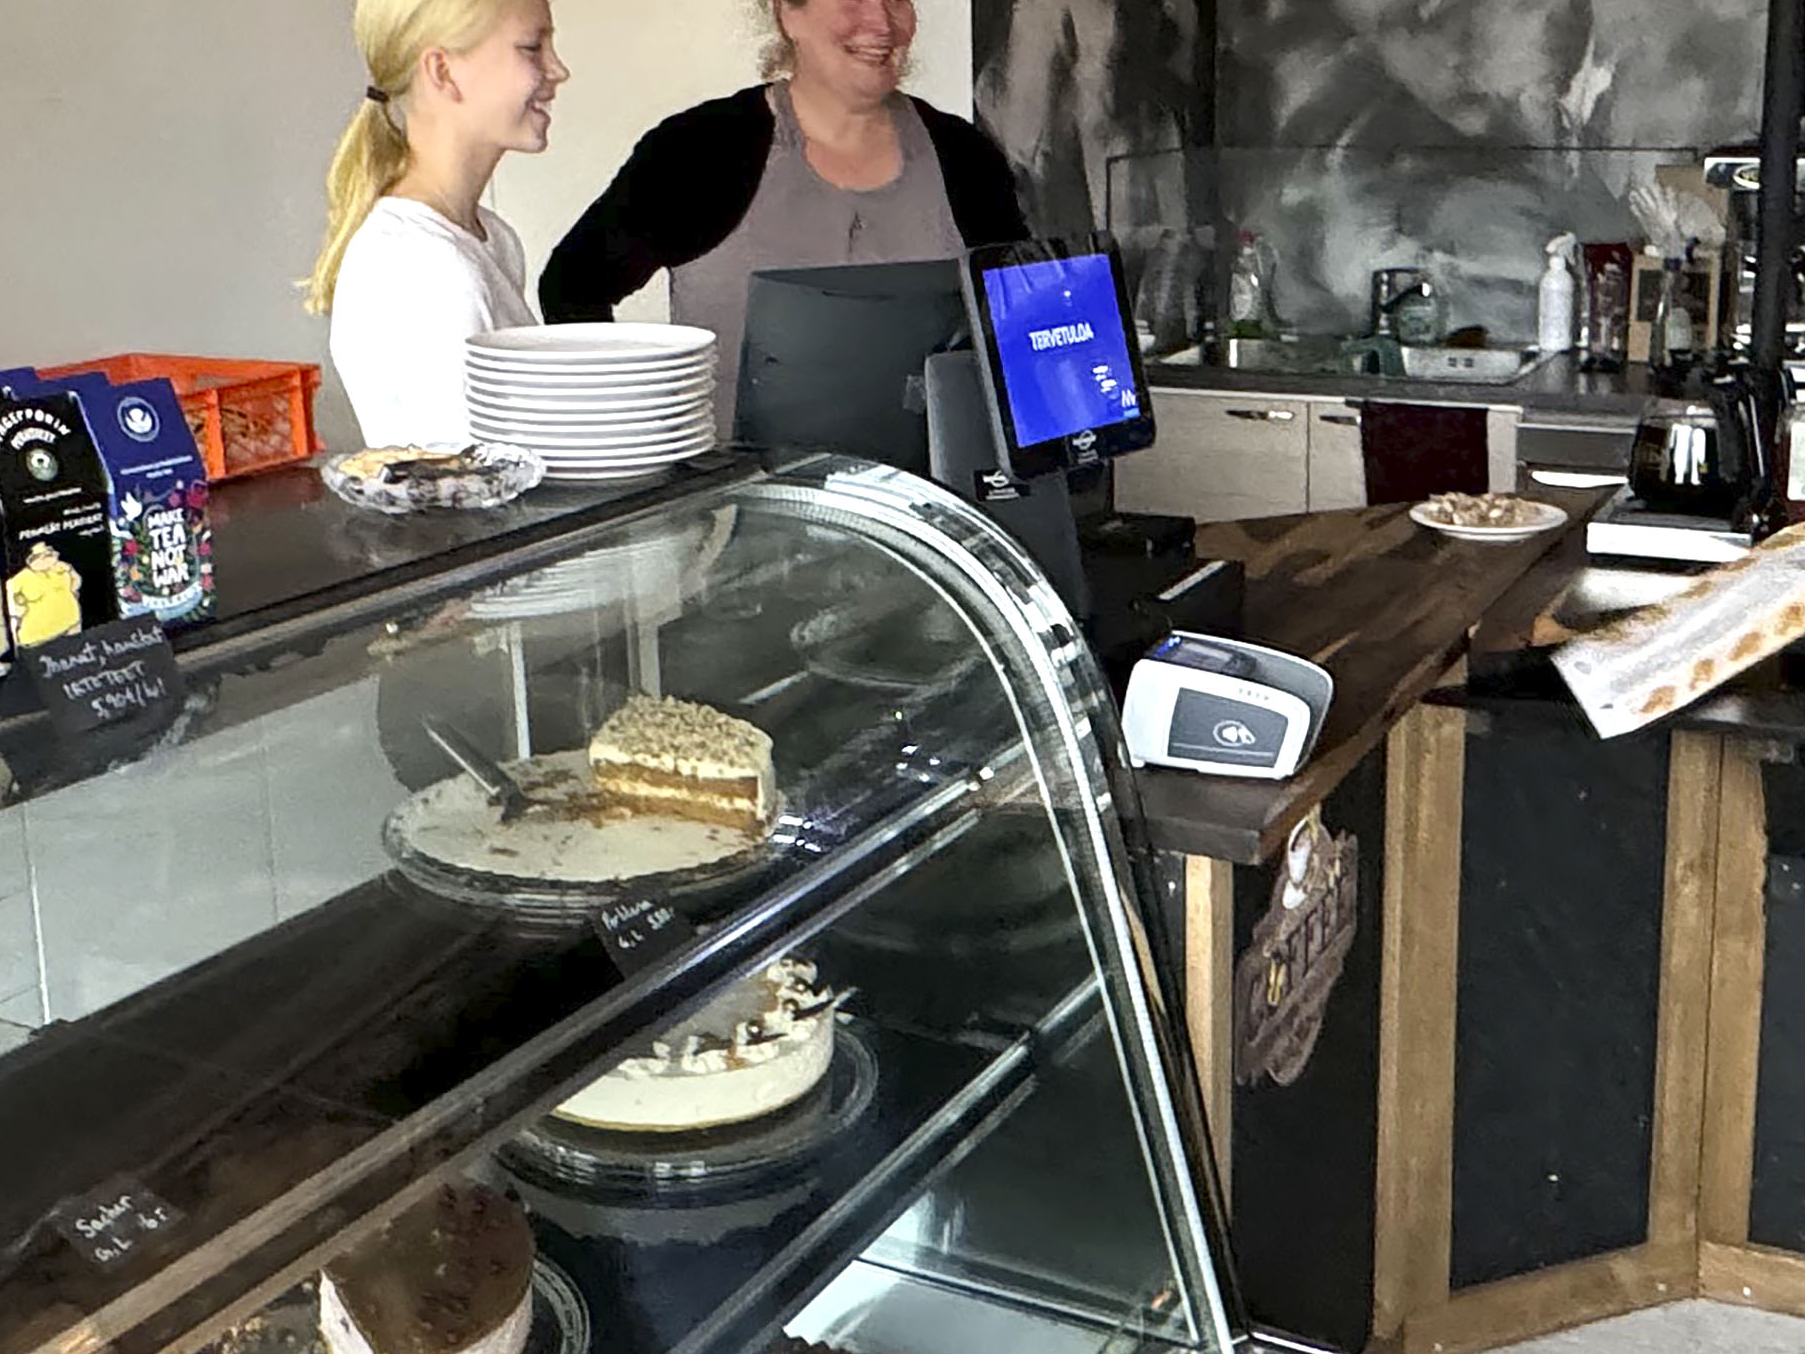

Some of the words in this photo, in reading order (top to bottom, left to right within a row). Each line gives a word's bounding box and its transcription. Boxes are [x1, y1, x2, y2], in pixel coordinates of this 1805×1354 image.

[1029, 321, 1094, 352] TERVETULOA
[148, 508, 185, 529] MAKE
[150, 527, 186, 549] TEA
[151, 547, 187, 570] NOT
[153, 564, 189, 588] WAR
